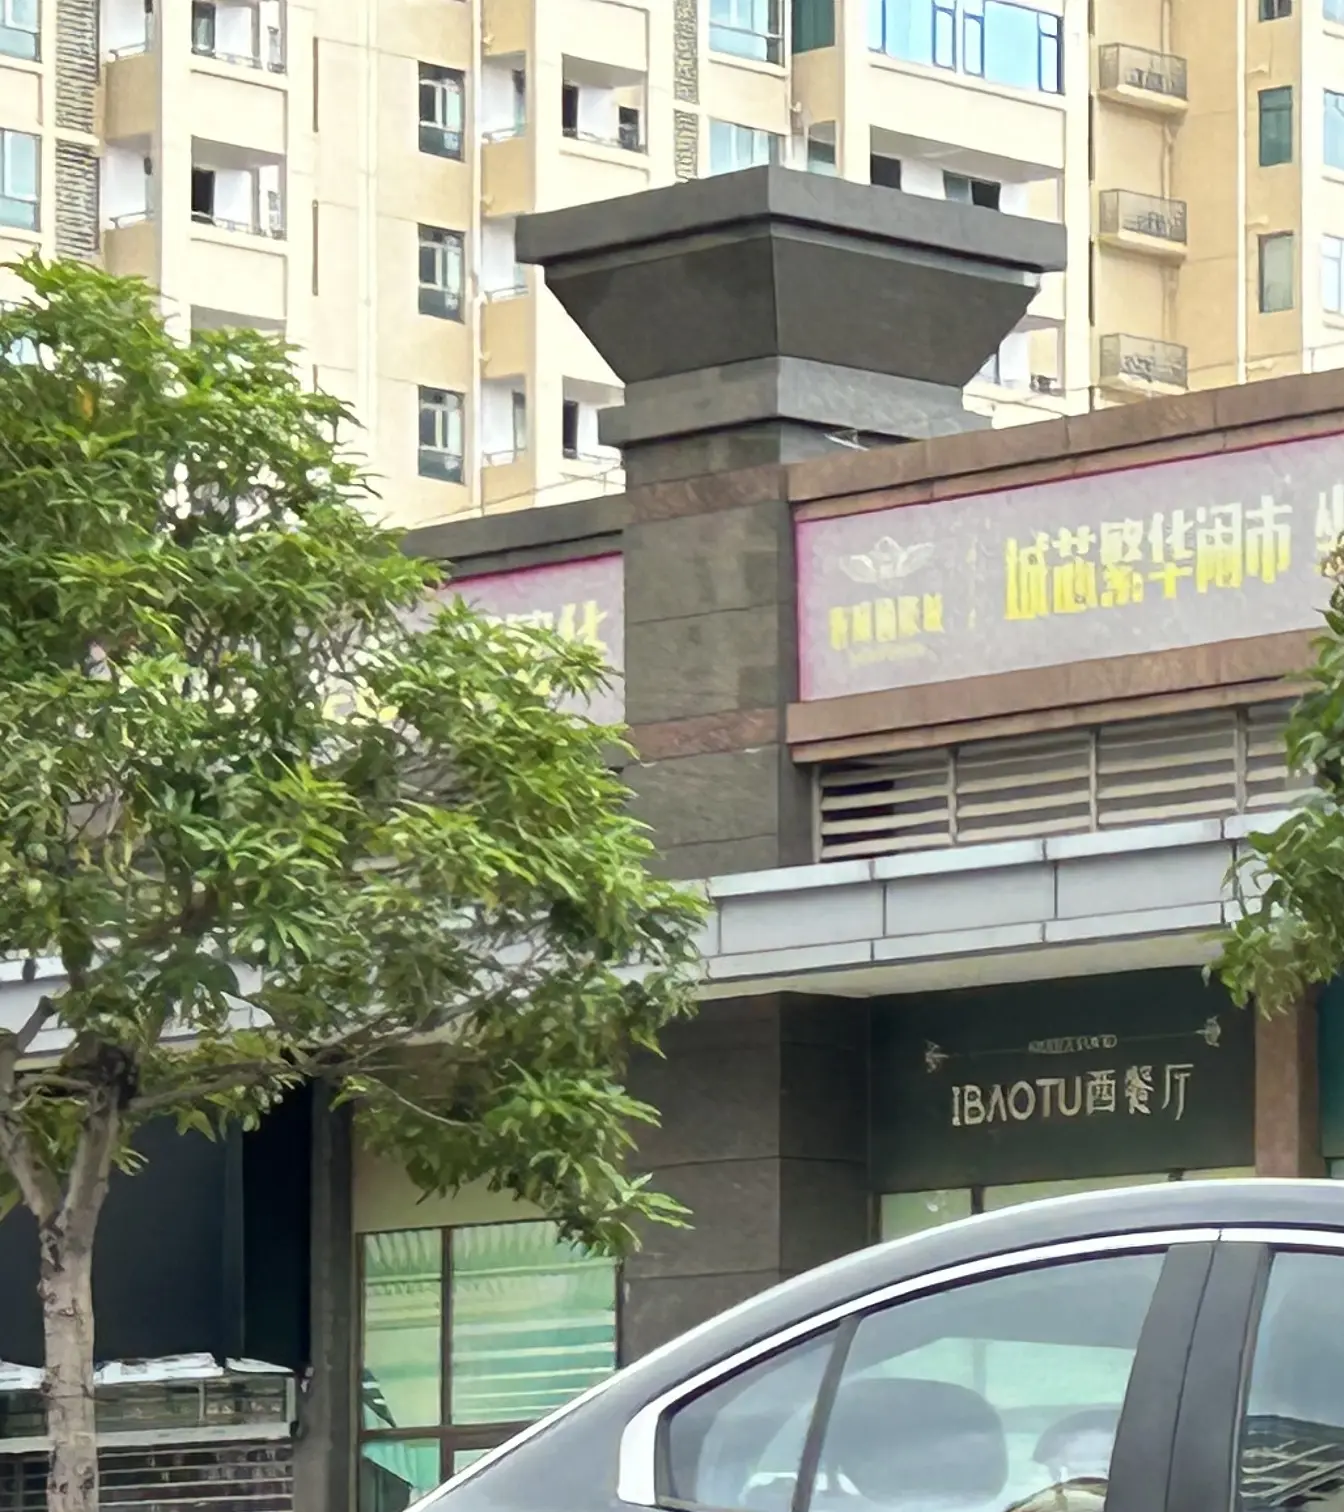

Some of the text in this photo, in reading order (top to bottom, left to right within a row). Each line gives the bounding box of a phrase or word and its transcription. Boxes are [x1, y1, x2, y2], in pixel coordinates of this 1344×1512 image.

[1003, 494, 1293, 620] 城芯繁华闹市
